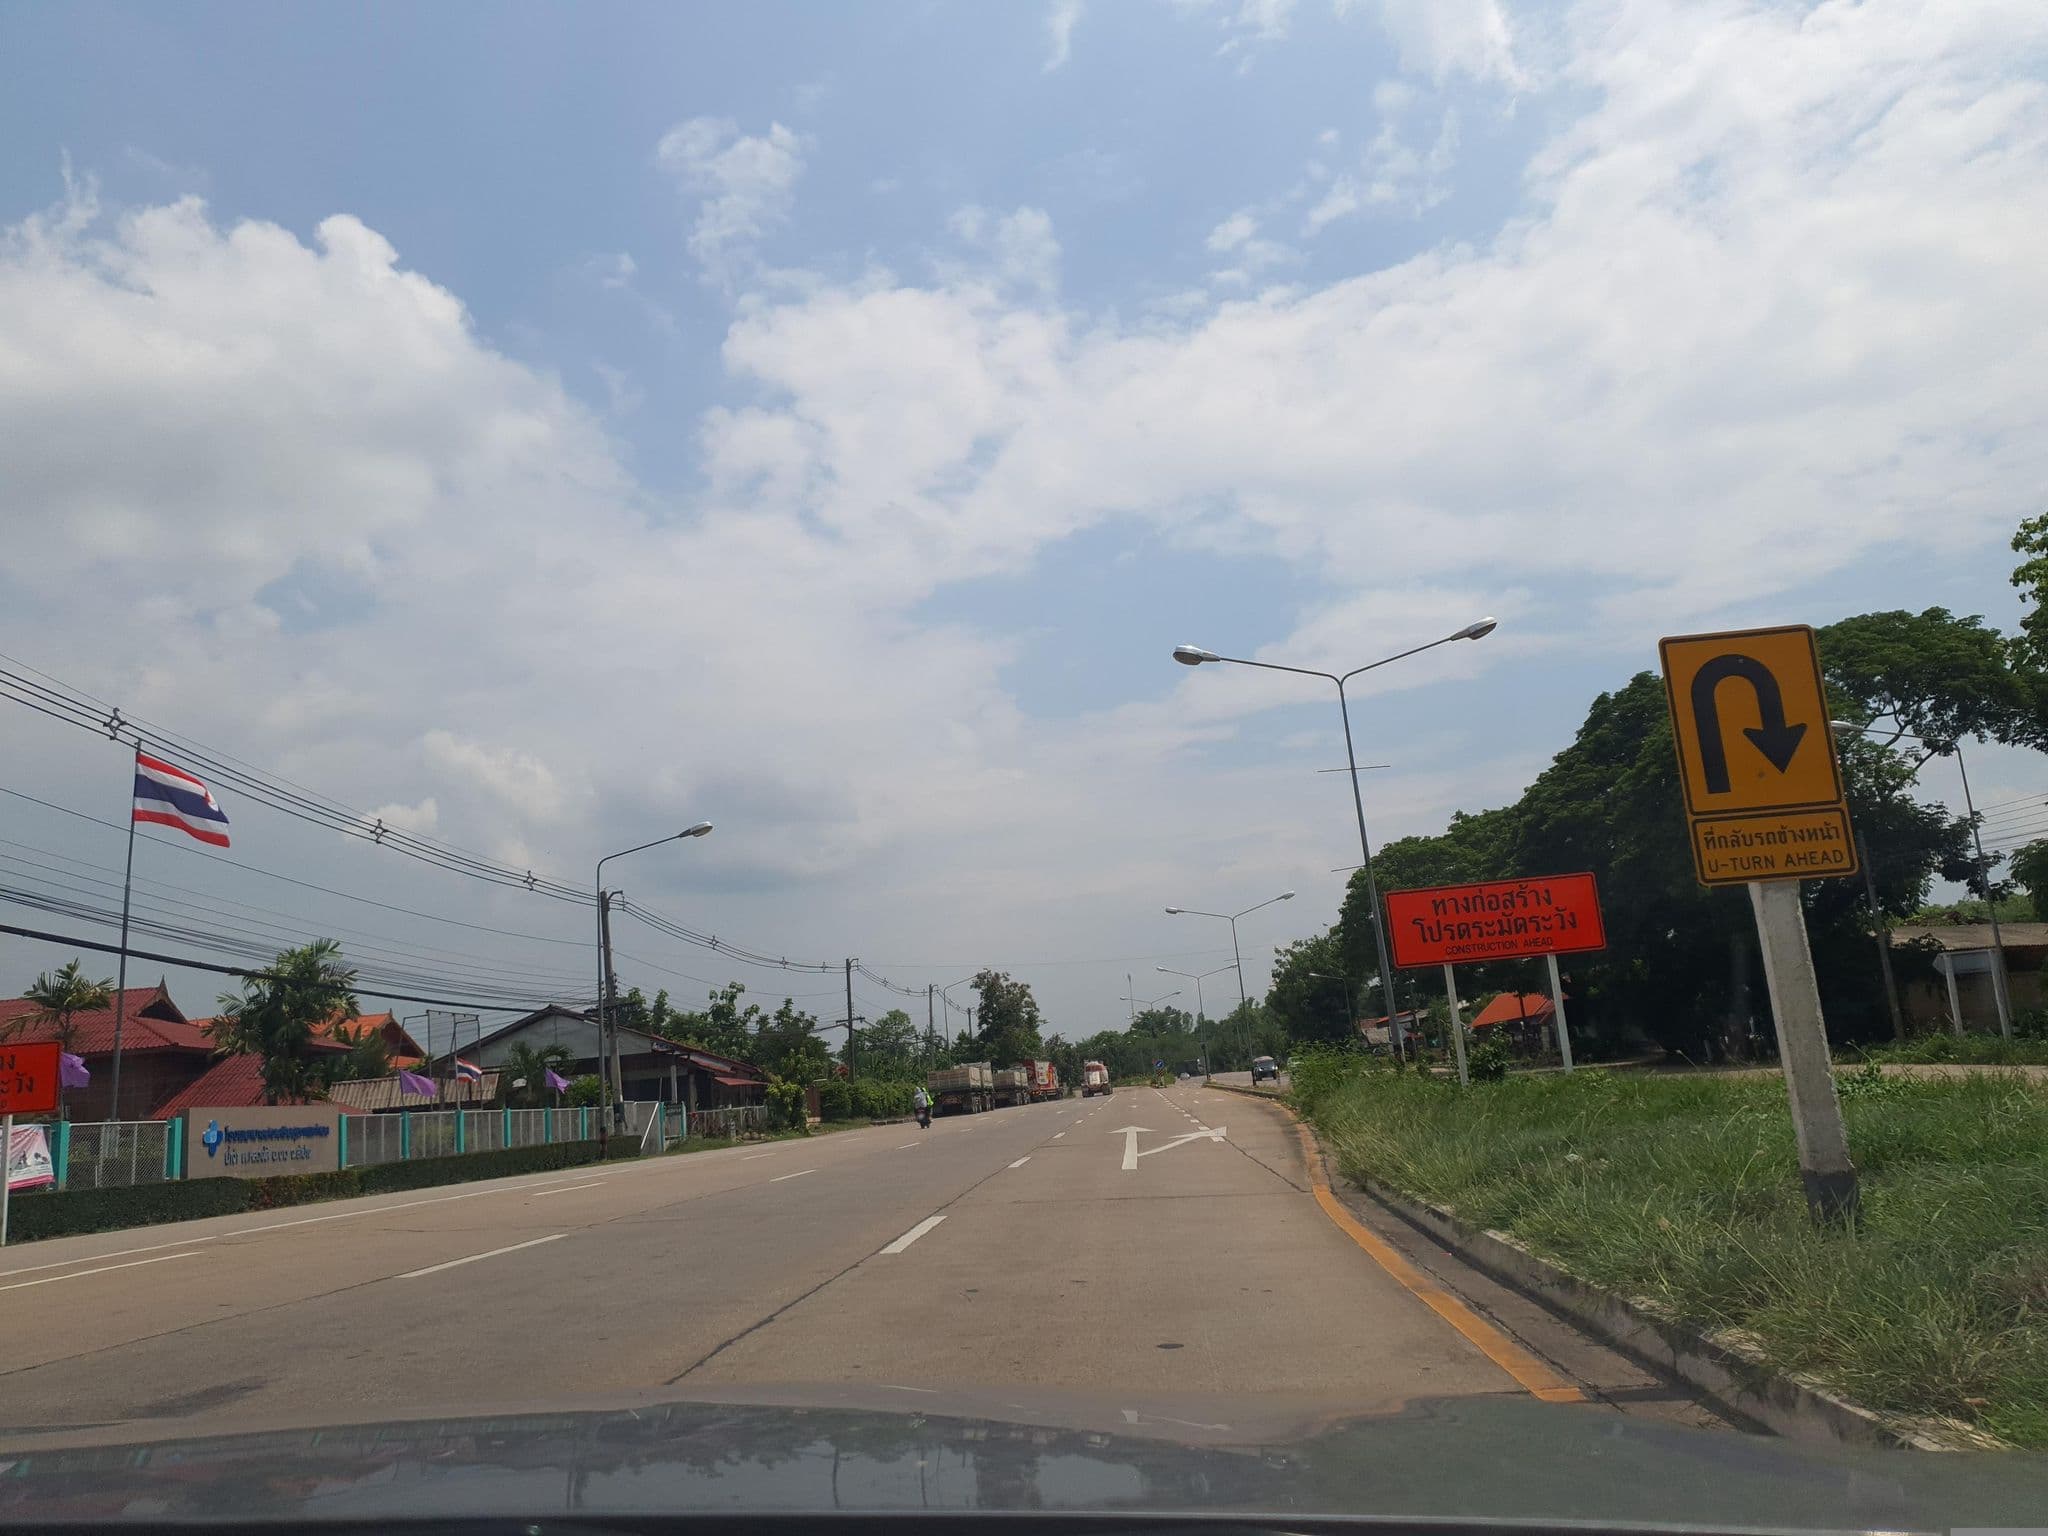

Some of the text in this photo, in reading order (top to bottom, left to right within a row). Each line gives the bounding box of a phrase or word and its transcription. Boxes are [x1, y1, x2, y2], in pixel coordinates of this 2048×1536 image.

[1703, 822, 1840, 850] ที่กลับรถข้างหน้า
[1708, 849, 1844, 873] U-TURN AHEAD
[1432, 884, 1552, 916] ทางก่อสร้าง
[1412, 906, 1577, 944] โปรดระมัดระวัง
[1446, 937, 1553, 955] CONSTRUCTION AHEAD
